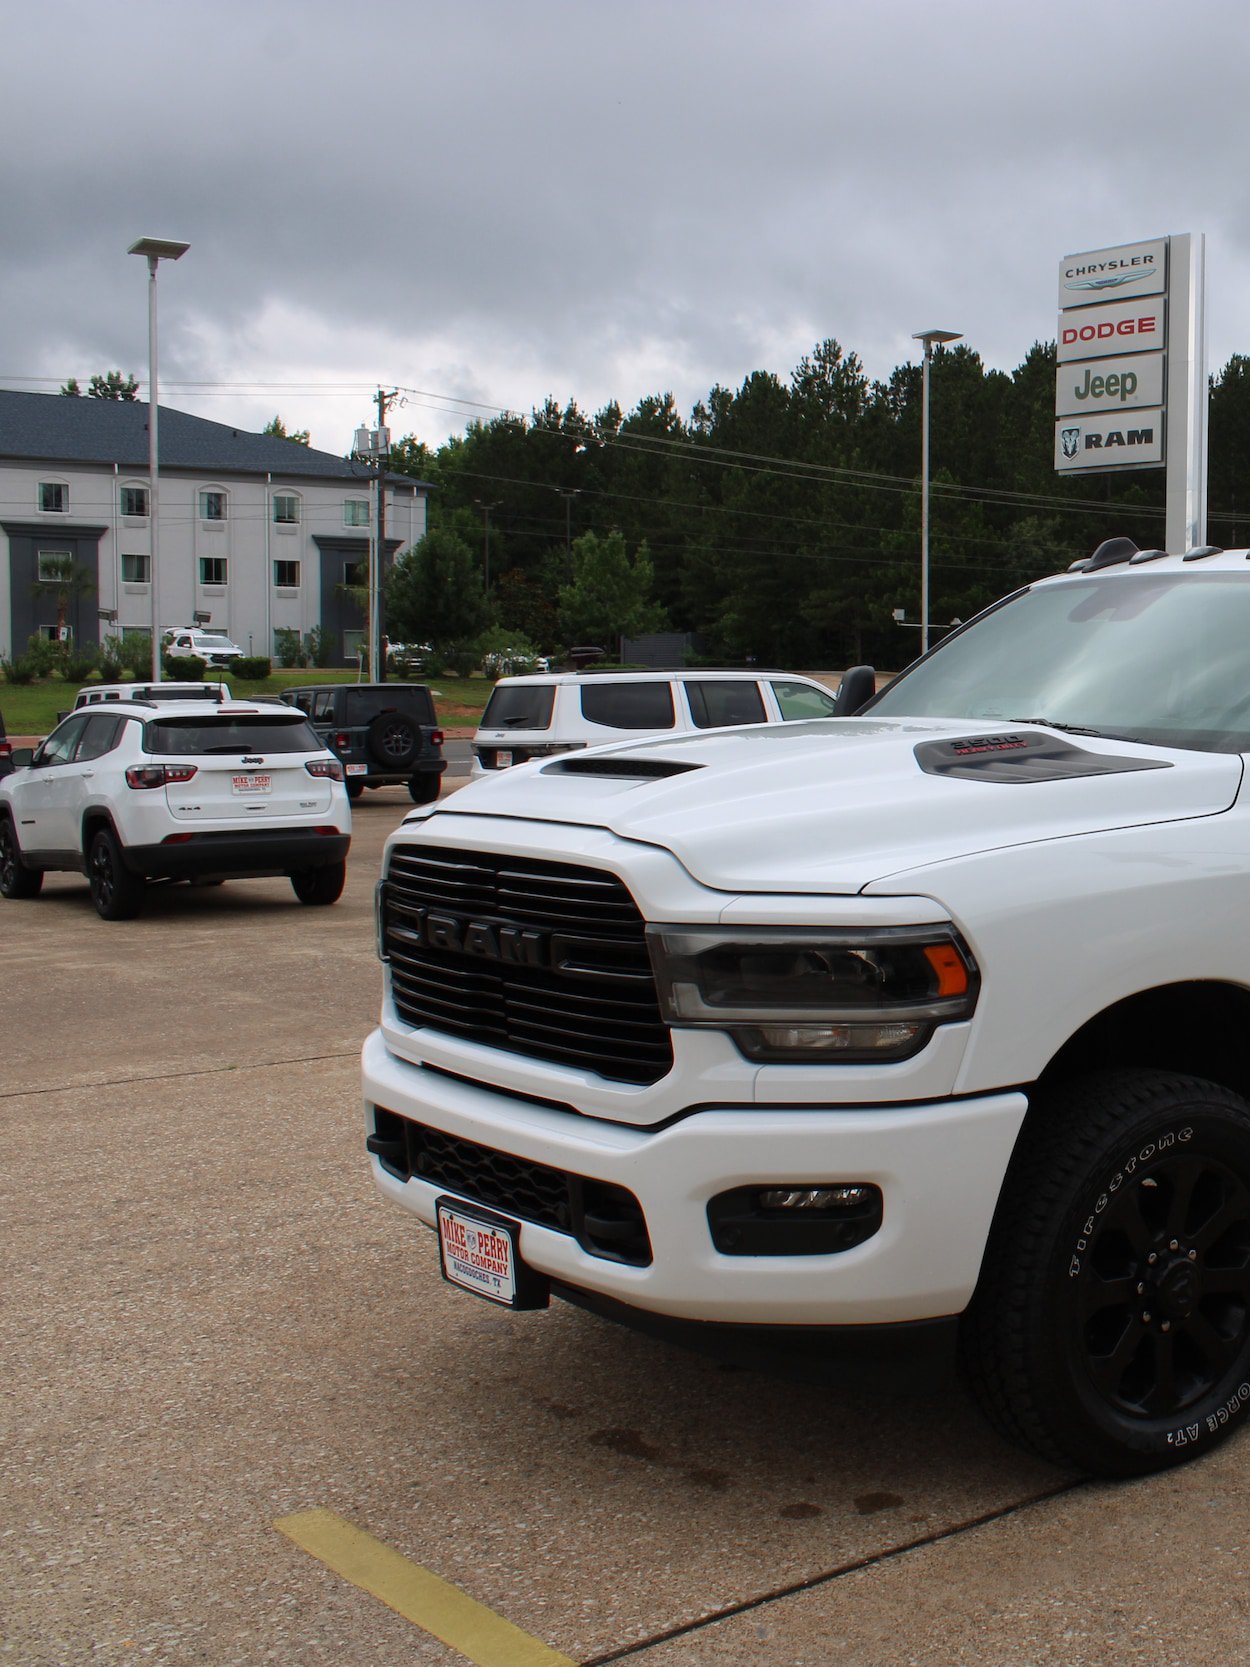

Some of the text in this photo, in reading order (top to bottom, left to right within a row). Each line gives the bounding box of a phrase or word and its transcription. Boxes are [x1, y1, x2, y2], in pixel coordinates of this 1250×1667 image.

[1065, 255, 1154, 278] CHRYSLER
[1062, 316, 1156, 344] DODGE
[1074, 369, 1138, 401] Jeep
[1085, 428, 1153, 449] RAM
[426, 913, 546, 967] RAM
[443, 1218, 508, 1262] MIKE PERRY
[446, 1241, 509, 1276] MOTOR COMPANY
